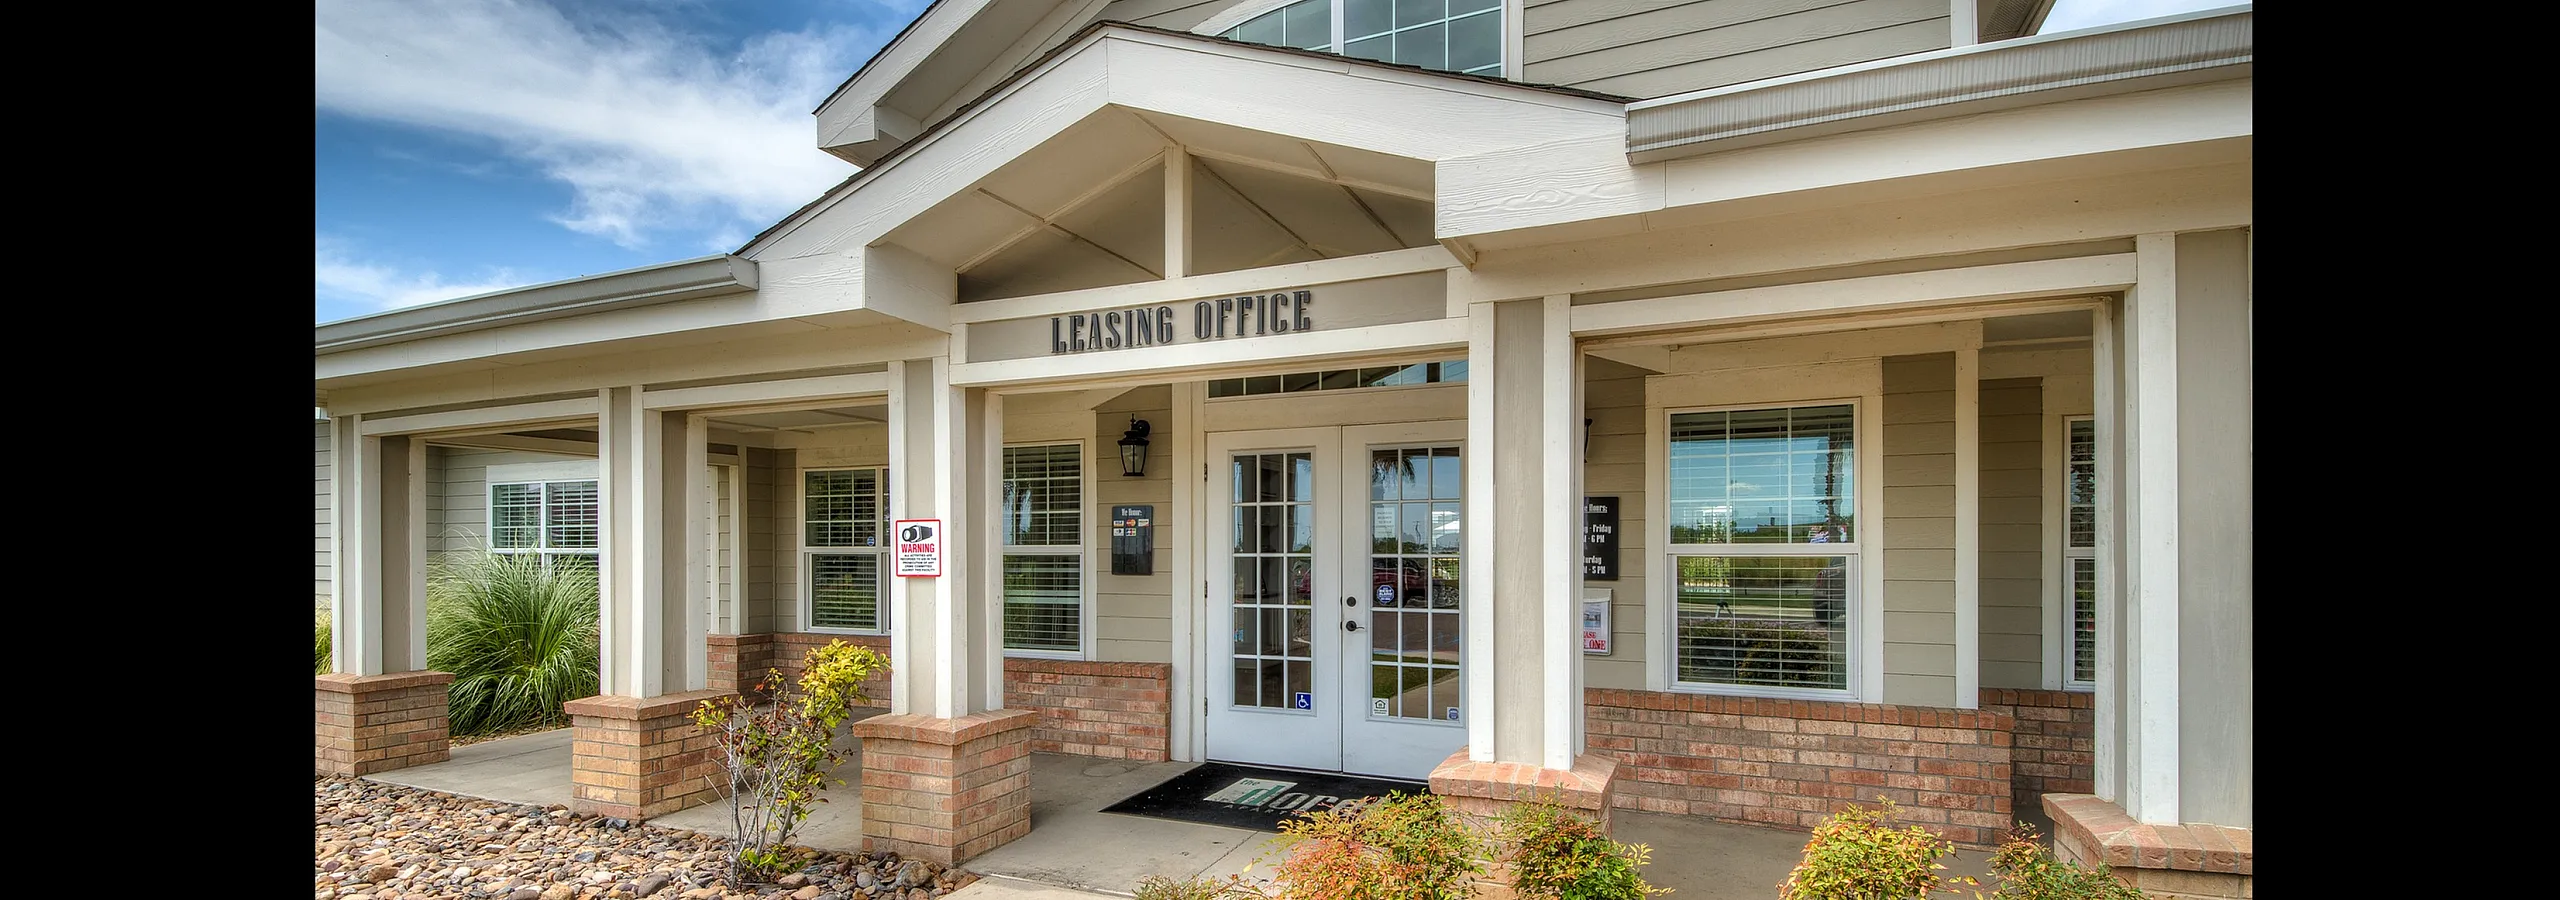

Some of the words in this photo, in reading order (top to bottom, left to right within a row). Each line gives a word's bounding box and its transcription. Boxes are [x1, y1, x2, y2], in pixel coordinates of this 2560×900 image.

[1051, 306, 1173, 353] LEASING
[1194, 290, 1311, 339] OFFICE
[1592, 524, 1612, 534] Friday
[1596, 534, 1605, 543] PM
[901, 543, 935, 553] WARNING
[1597, 566, 1606, 574] PM
[1589, 640, 1606, 650] ONE
